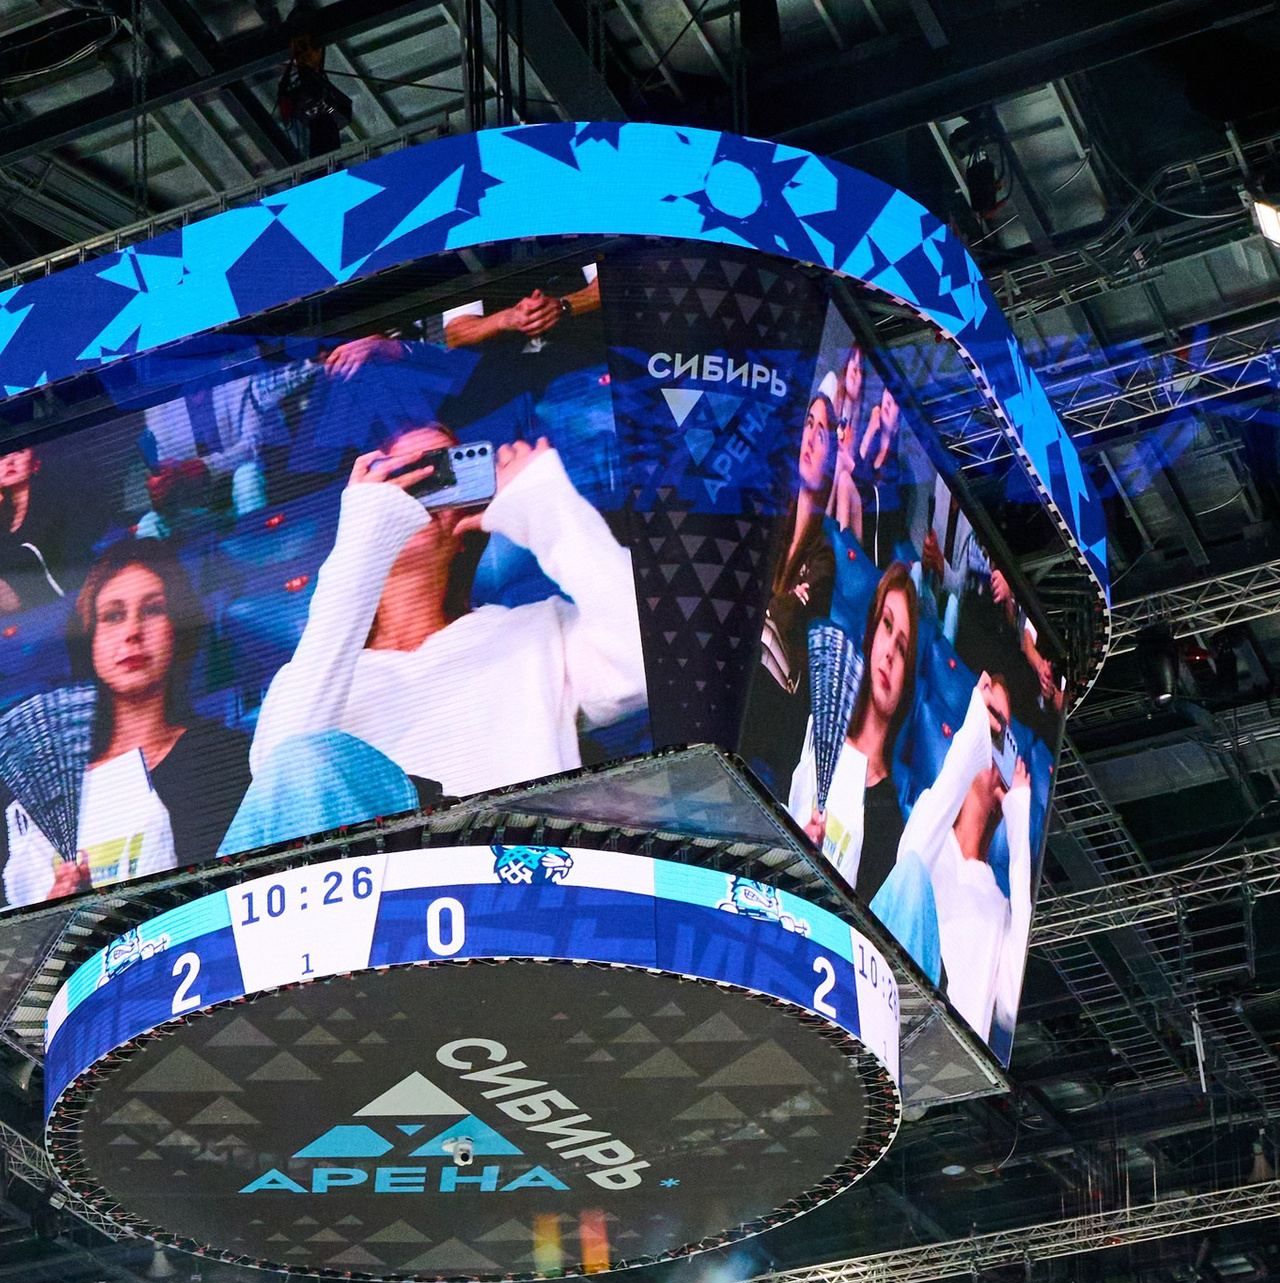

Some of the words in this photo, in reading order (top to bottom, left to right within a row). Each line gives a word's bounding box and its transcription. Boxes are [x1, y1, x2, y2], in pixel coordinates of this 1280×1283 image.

[647, 352, 787, 397] СИБИРЬ
[703, 401, 778, 505] АРЕНА
[240, 866, 373, 927] 10:26
[426, 896, 466, 956] 0
[171, 951, 201, 1015] 2
[301, 953, 315, 976] 1
[812, 956, 837, 1019] 2
[435, 1037, 643, 1192] СИБИРЬ
[238, 1166, 570, 1194] АРЕНА
